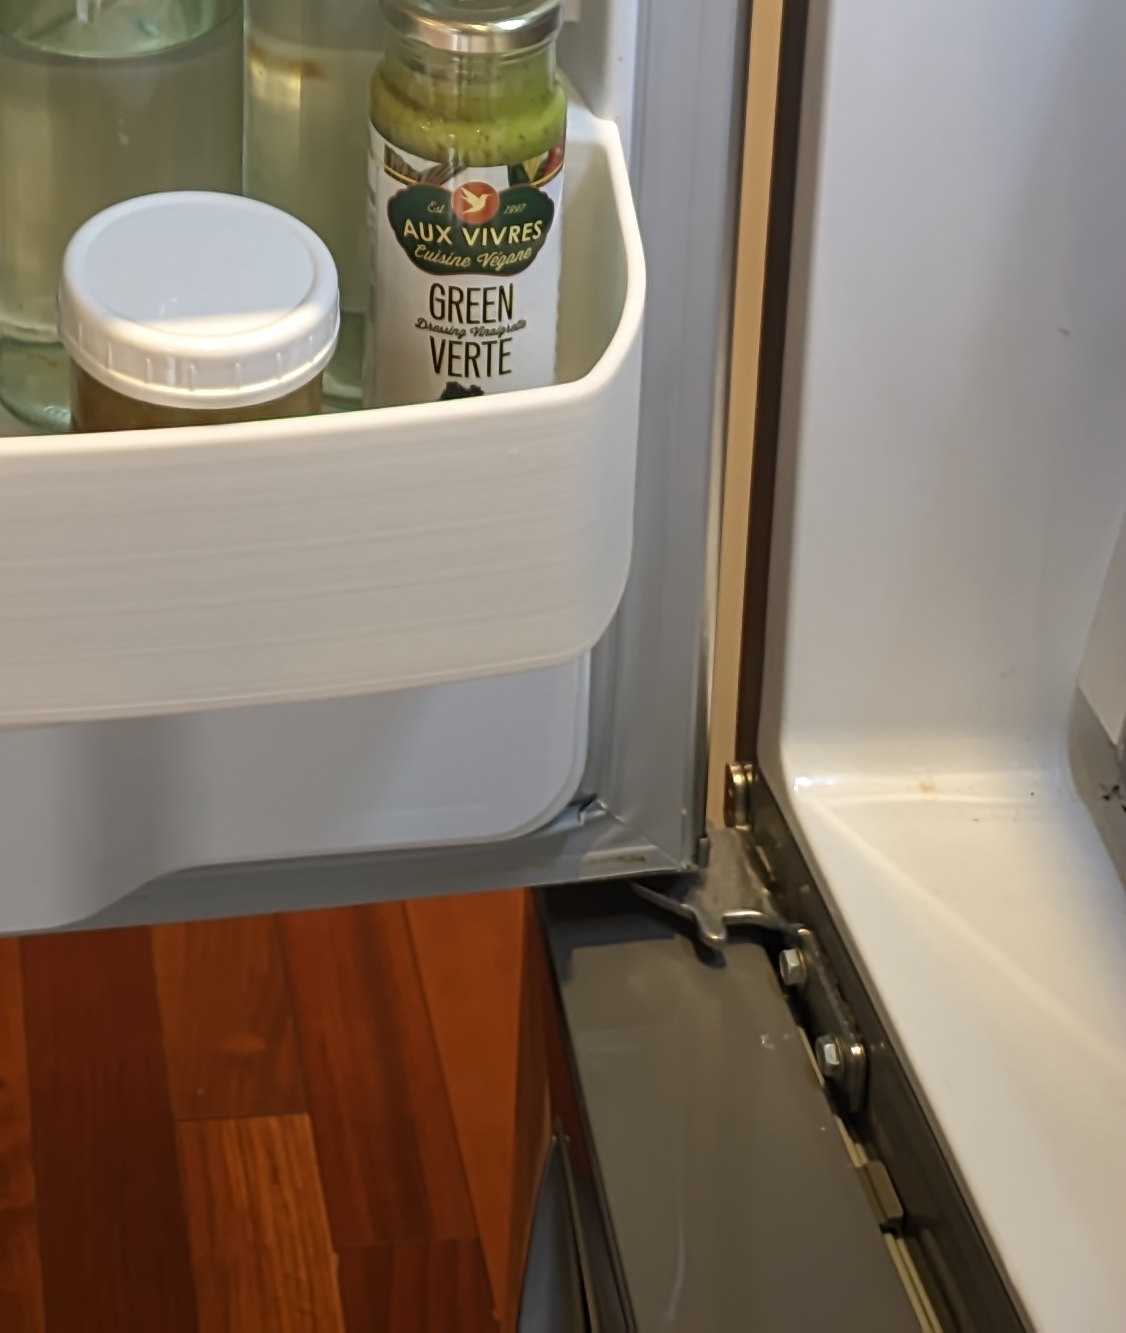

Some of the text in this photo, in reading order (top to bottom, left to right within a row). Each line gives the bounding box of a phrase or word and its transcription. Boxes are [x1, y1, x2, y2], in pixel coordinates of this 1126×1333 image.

[403, 219, 543, 247] AUX VIVRES
[414, 244, 533, 271] Cuisine Végane
[429, 283, 514, 325] GREEN
[415, 317, 467, 339] Dressing
[429, 335, 513, 379] VERTE
